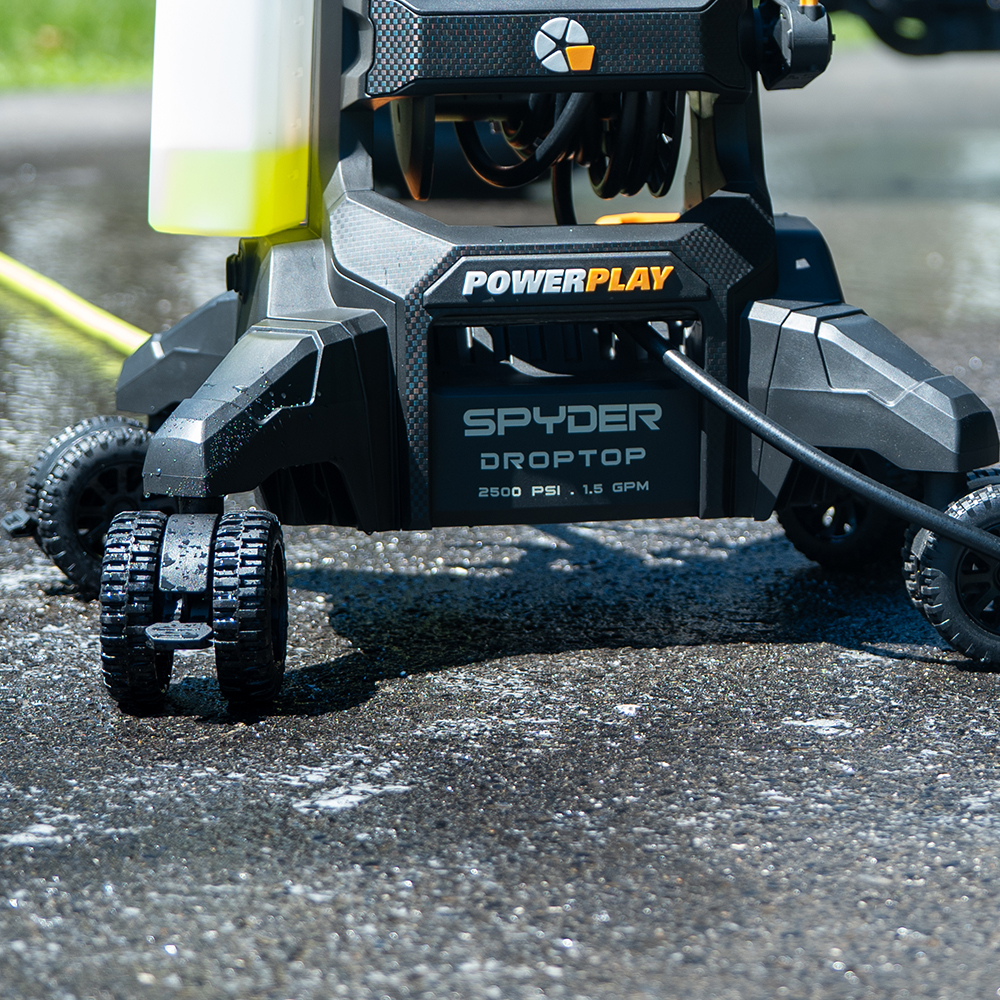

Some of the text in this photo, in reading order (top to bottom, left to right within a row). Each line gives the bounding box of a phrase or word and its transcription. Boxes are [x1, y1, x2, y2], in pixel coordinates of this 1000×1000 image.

[462, 266, 674, 295] POWERPLAY
[463, 403, 662, 436] SPYDER
[480, 447, 646, 470] DROPTOP
[478, 486, 521, 497] 2500
[531, 485, 561, 496] PSI
[582, 483, 603, 495] 1.5
[612, 481, 649, 493] GPM
